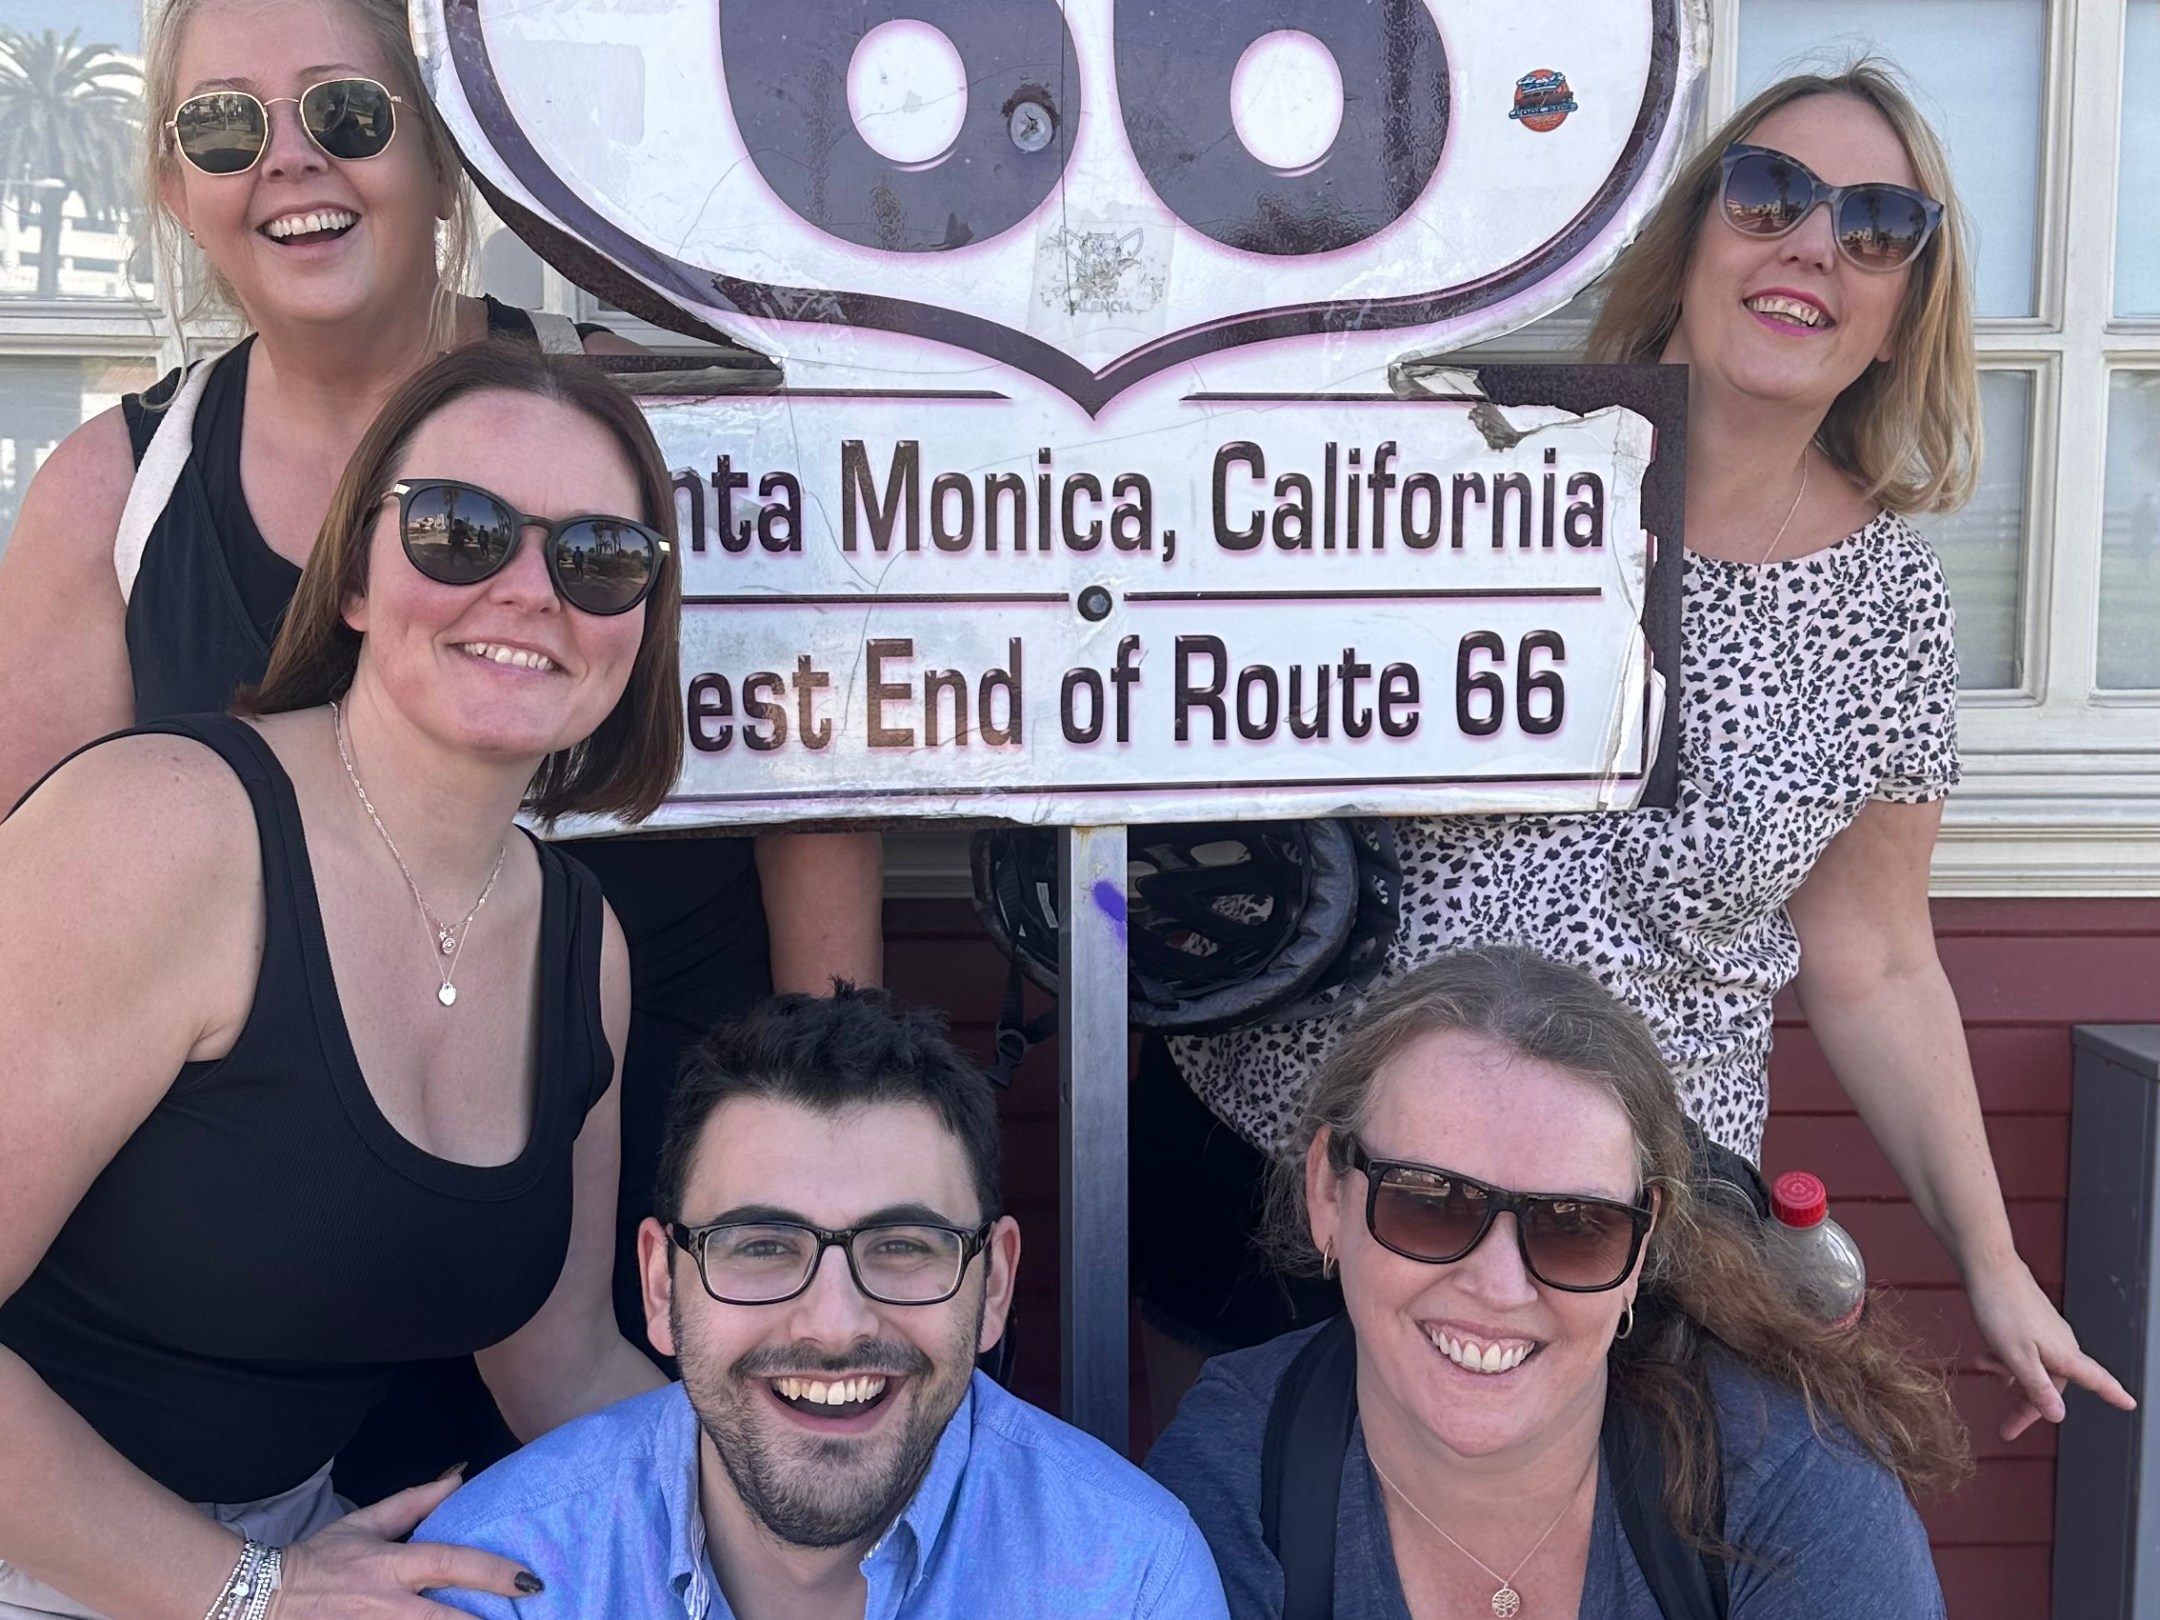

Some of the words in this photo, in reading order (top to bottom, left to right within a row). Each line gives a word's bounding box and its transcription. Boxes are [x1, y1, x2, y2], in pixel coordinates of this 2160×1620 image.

[671, 454, 802, 553] nta
[841, 439, 1177, 563] Monica,
[1212, 440, 1604, 551] California
[687, 654, 832, 752] est
[866, 637, 1023, 748] End
[1060, 634, 1141, 744] of
[1174, 634, 1420, 741] Route
[1455, 629, 1566, 736] 66
